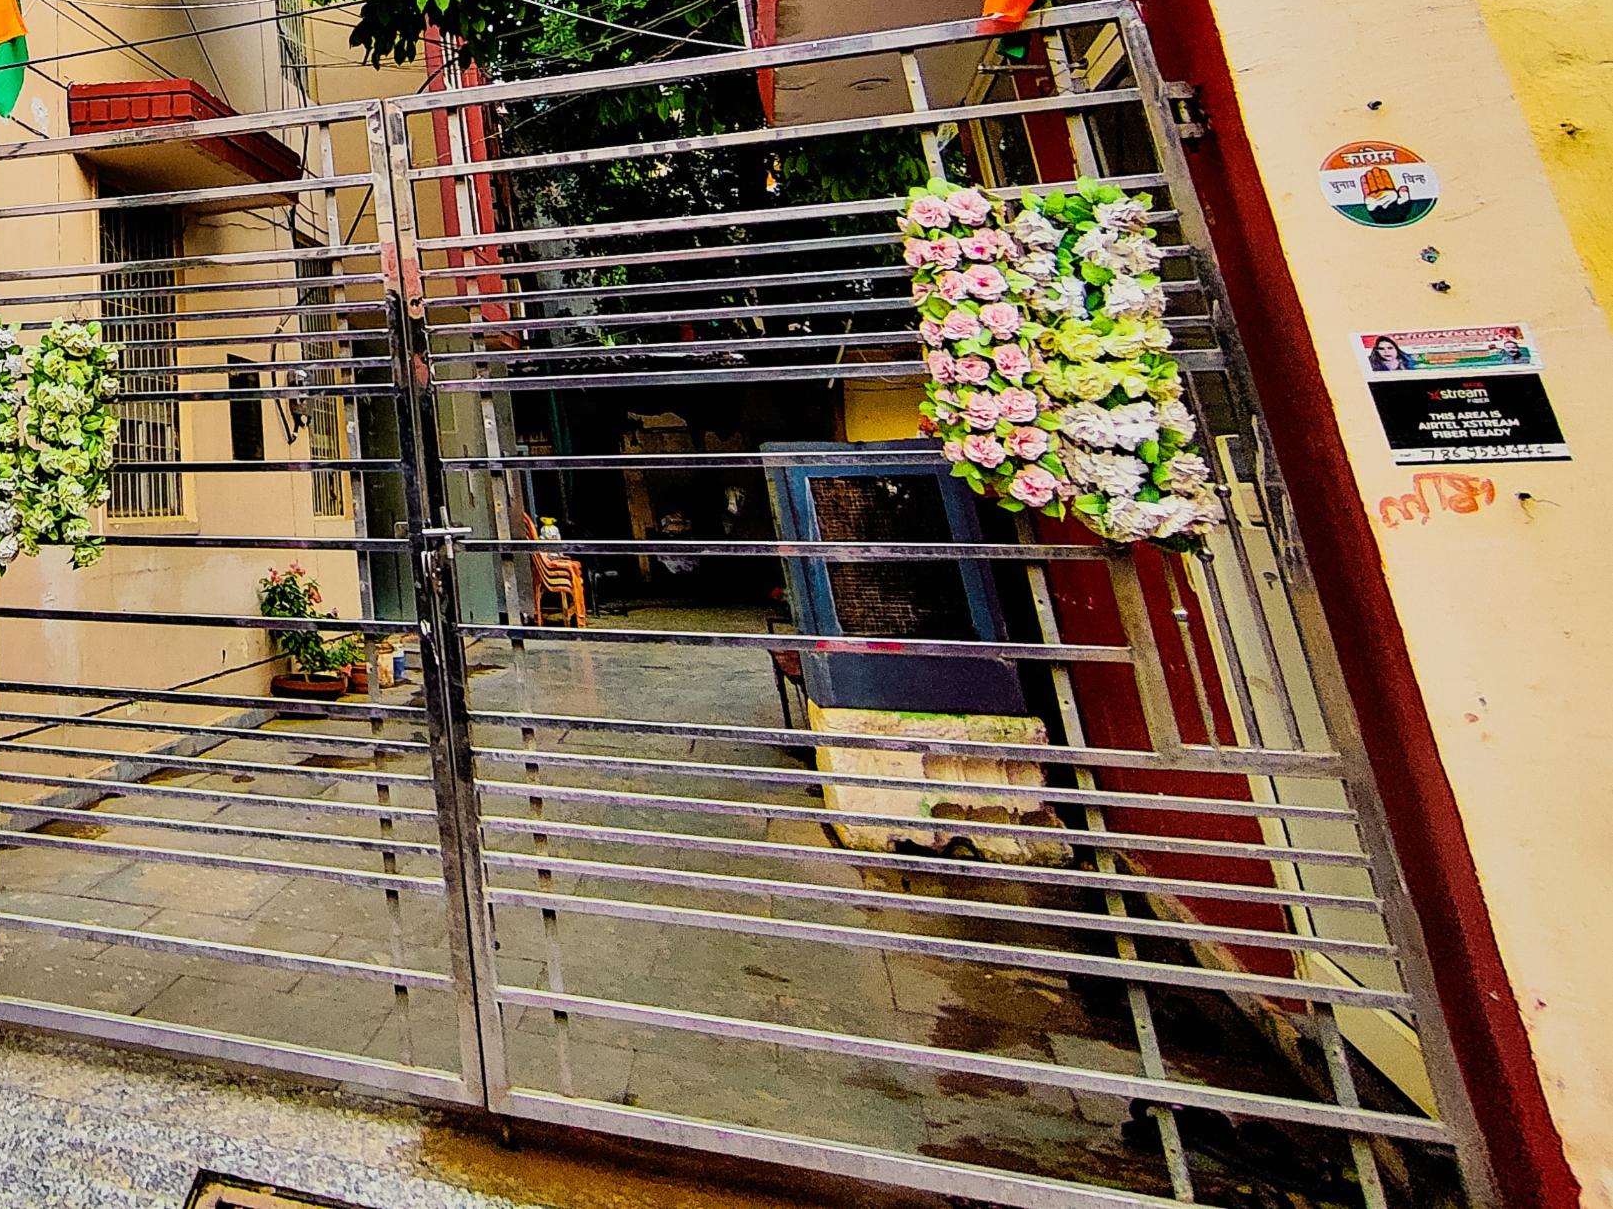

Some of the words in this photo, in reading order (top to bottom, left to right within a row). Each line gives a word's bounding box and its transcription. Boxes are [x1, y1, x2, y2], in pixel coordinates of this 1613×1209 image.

[1340, 147, 1396, 164] कांग्रेस
[1402, 172, 1426, 185] चिन्ह
[1428, 412, 1456, 421] THIS
[1457, 410, 1488, 420] AREA
[1489, 410, 1502, 418] IS
[1418, 420, 1460, 431] AIRTEL
[1462, 418, 1521, 429] XSTREAM
[1432, 429, 1468, 439] FIBER
[1469, 428, 1512, 439] READY
